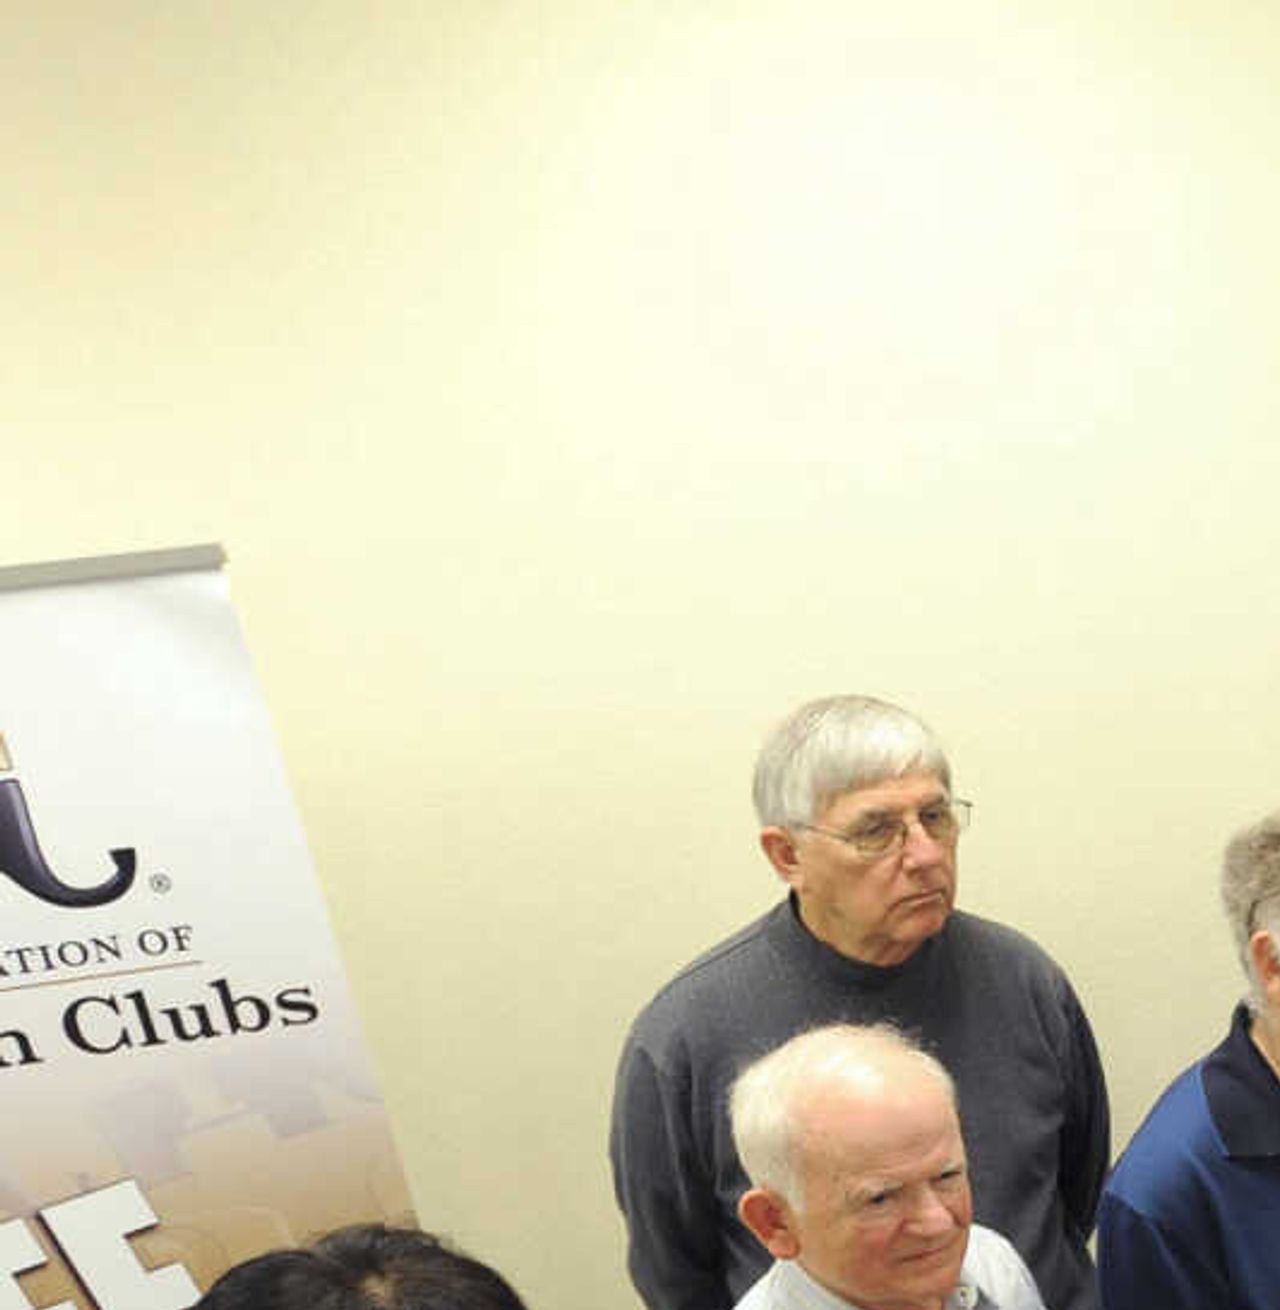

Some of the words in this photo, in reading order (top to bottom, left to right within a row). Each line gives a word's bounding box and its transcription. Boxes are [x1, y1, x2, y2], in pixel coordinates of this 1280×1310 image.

[0, 935, 122, 977] TION
[138, 925, 193, 956] OF
[62, 978, 319, 1055] Clubs
